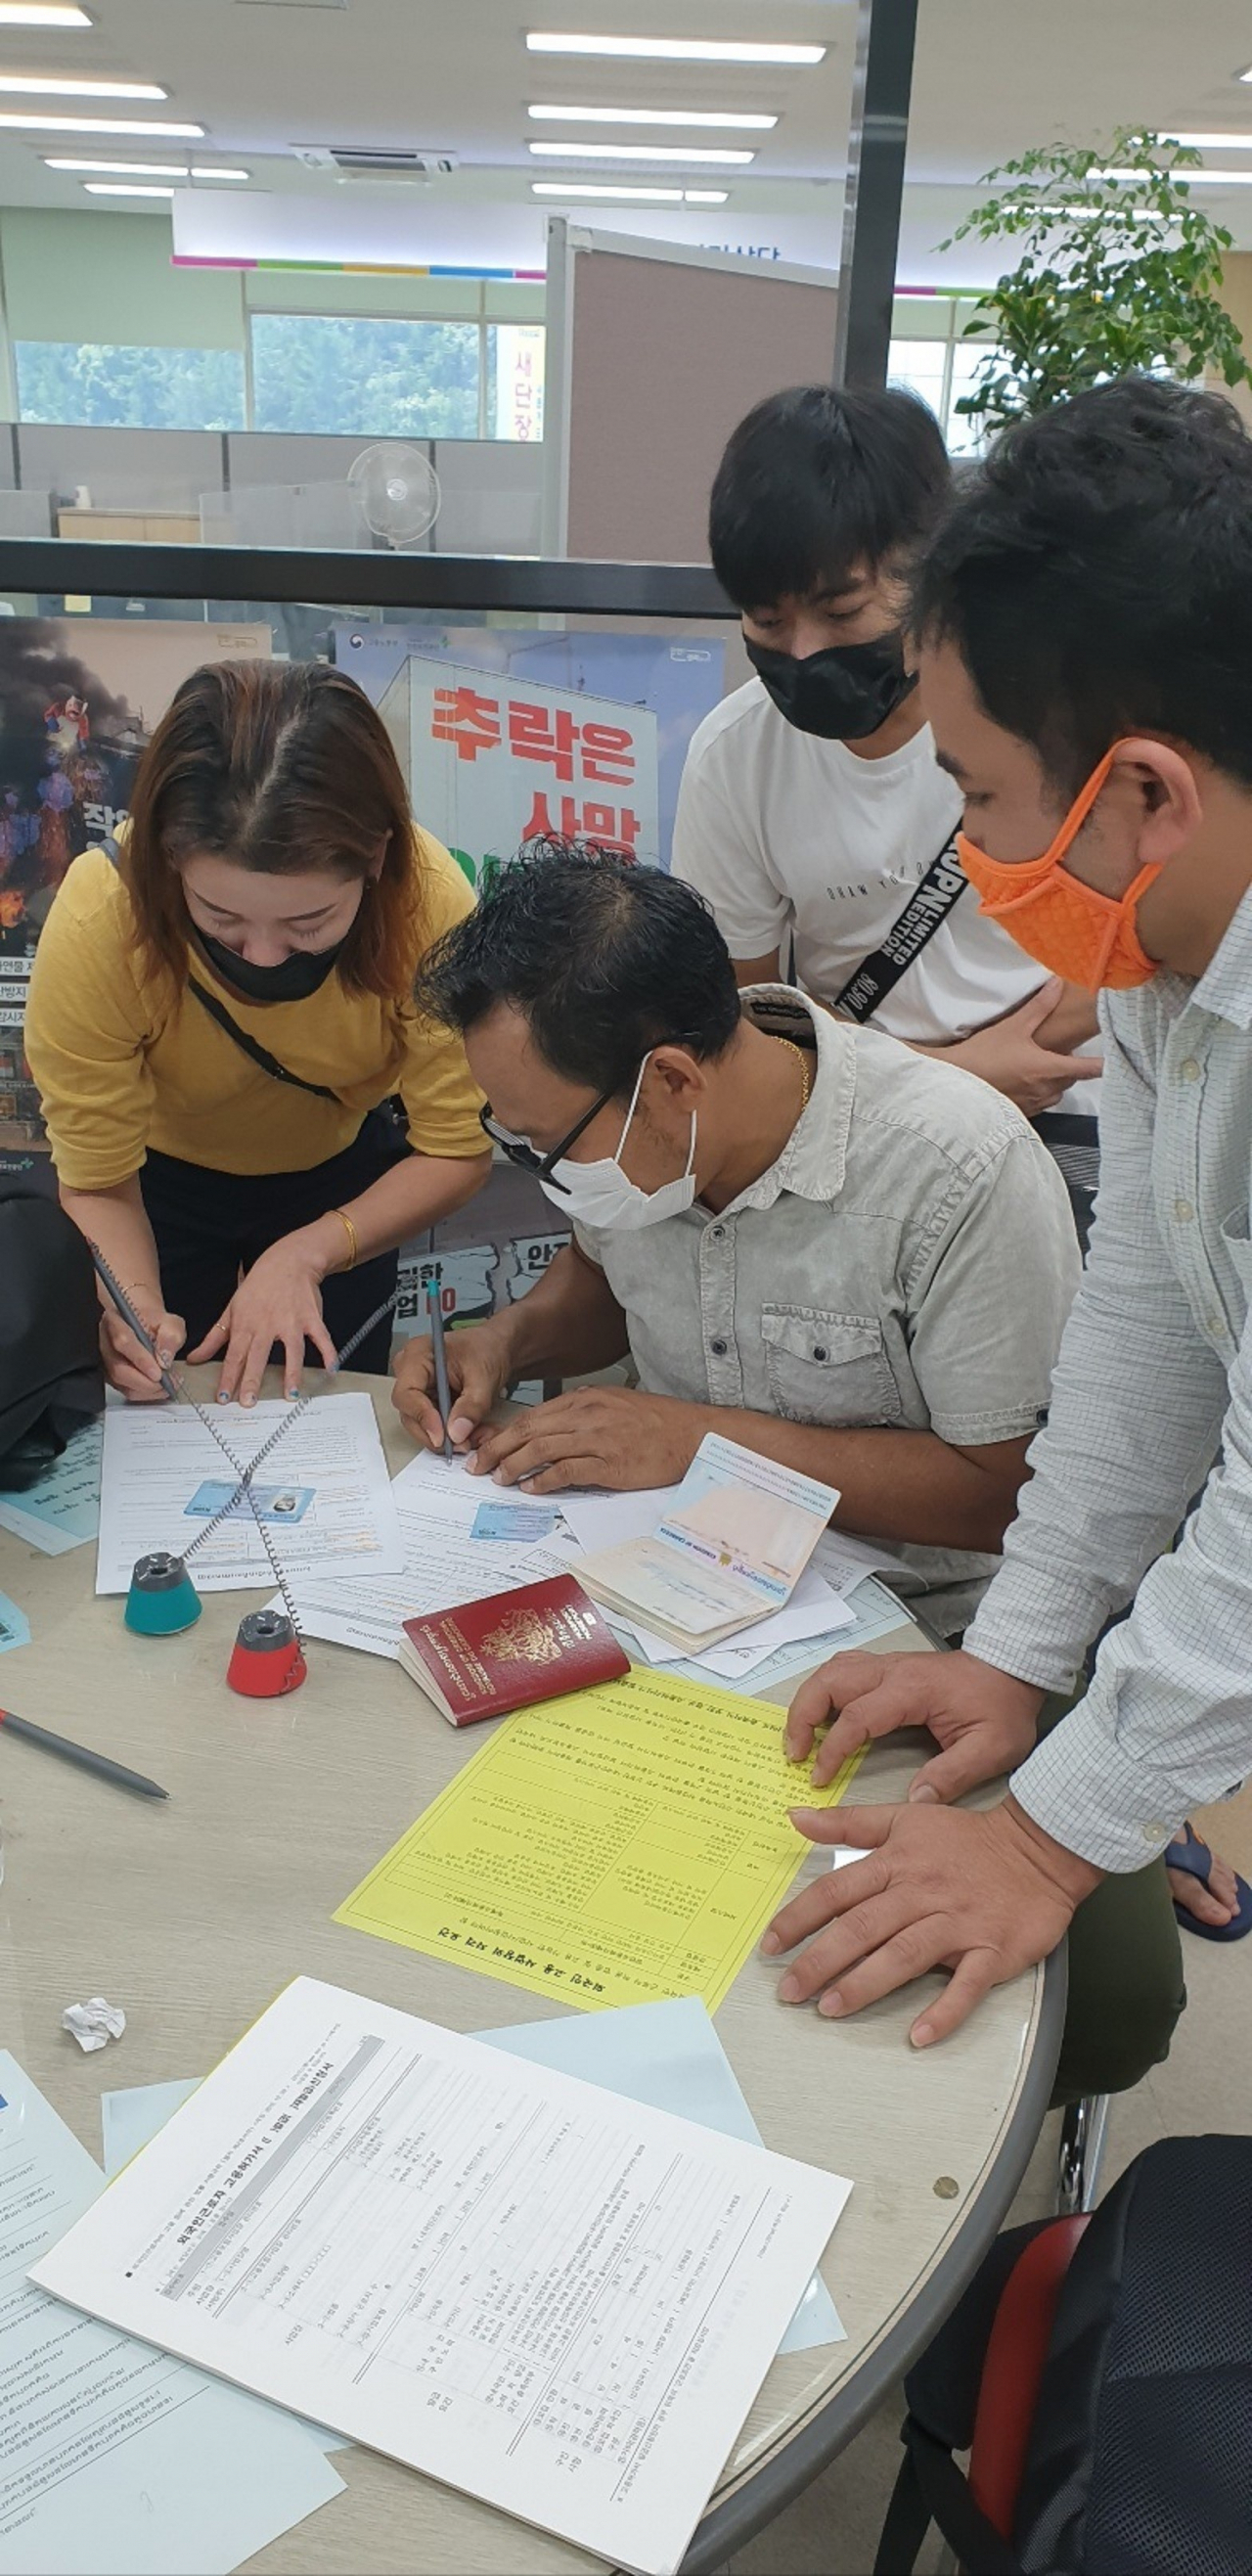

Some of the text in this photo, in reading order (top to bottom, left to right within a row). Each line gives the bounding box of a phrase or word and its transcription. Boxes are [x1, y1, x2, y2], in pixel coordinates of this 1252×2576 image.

[431, 687, 636, 787] 추락은
[917, 841, 963, 915] JPN
[879, 902, 925, 958] EDITION
[893, 910, 939, 966] LIMITED
[540, 1962, 568, 1979] 고용
[568, 1972, 607, 1993] 외국인
[174, 2189, 228, 2245] 외국인근로자
[221, 2144, 265, 2189] 고용허가서
